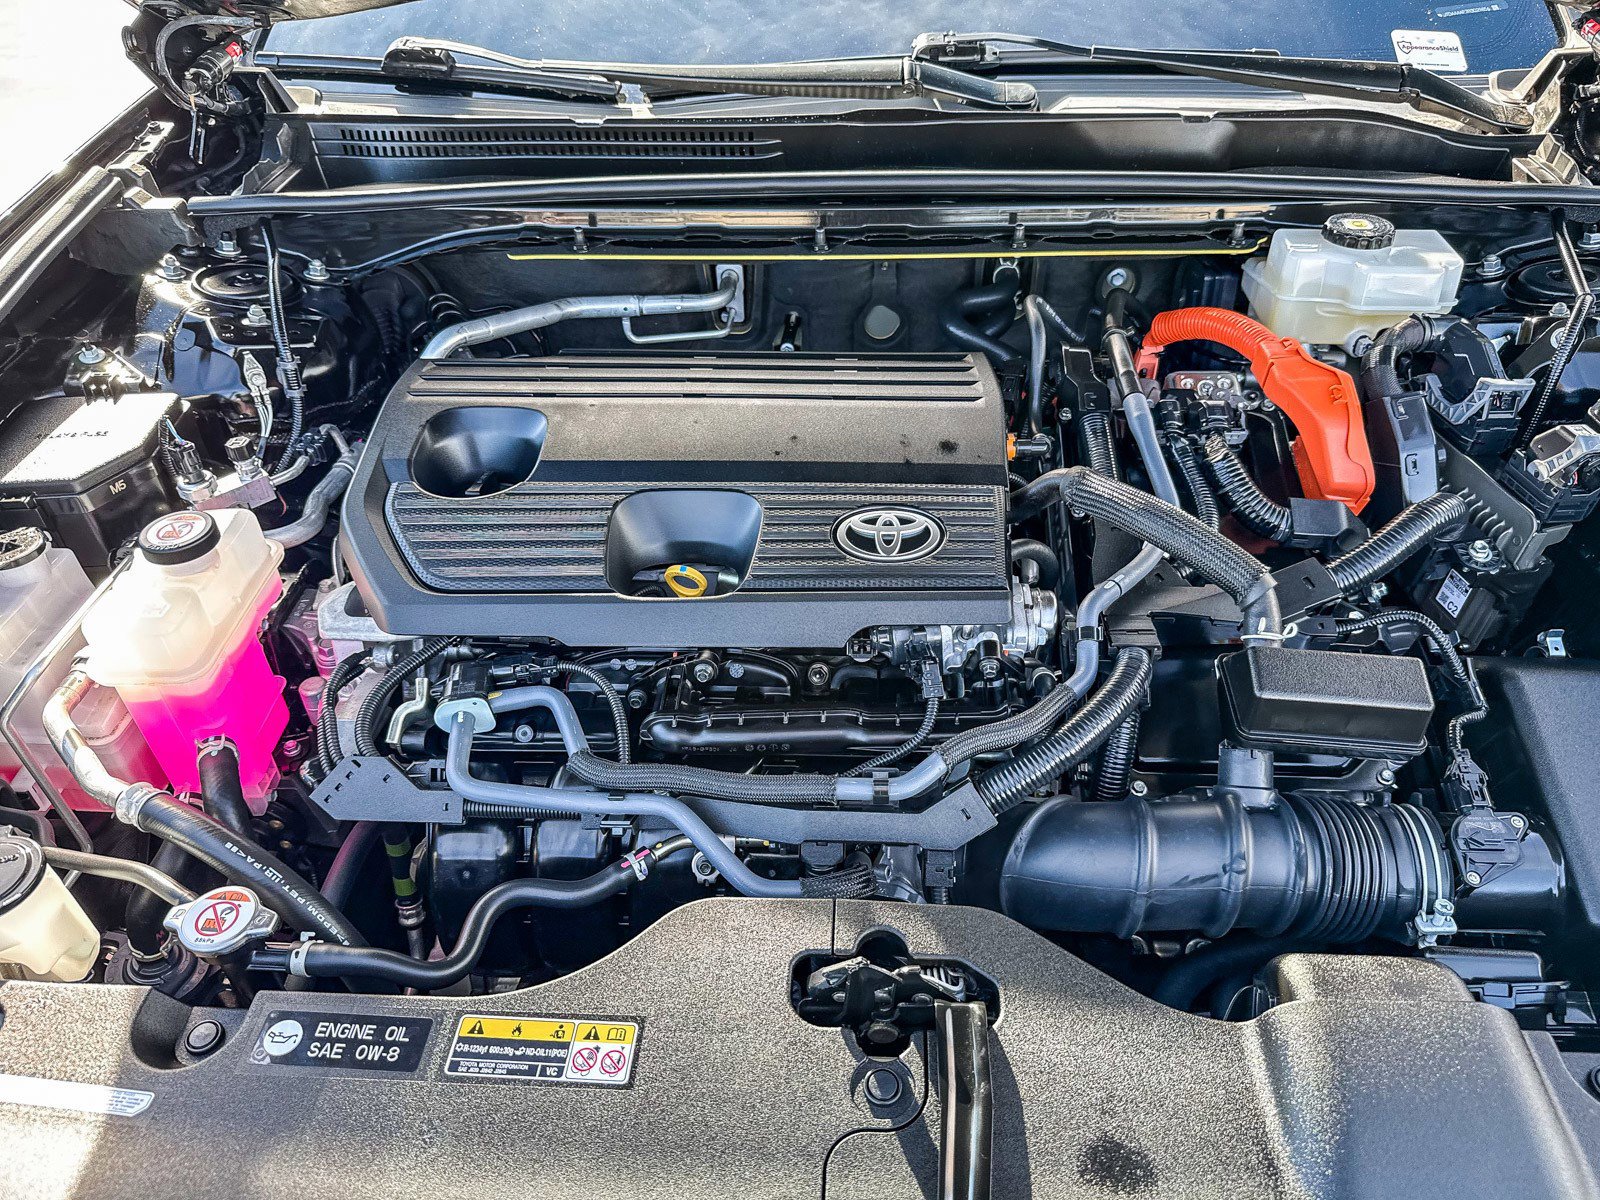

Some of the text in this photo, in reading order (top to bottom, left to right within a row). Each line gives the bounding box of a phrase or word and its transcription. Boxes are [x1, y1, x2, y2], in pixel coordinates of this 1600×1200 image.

[1402, 44, 1459, 52] AppearanceShield
[109, 479, 127, 495] M5
[1447, 601, 1459, 615] C2
[314, 1022, 410, 1042] ENGINE OIL
[307, 1042, 401, 1062] SAE 0W-8
[496, 1063, 529, 1071] CORPORATION
[546, 1066, 559, 1076] VC
